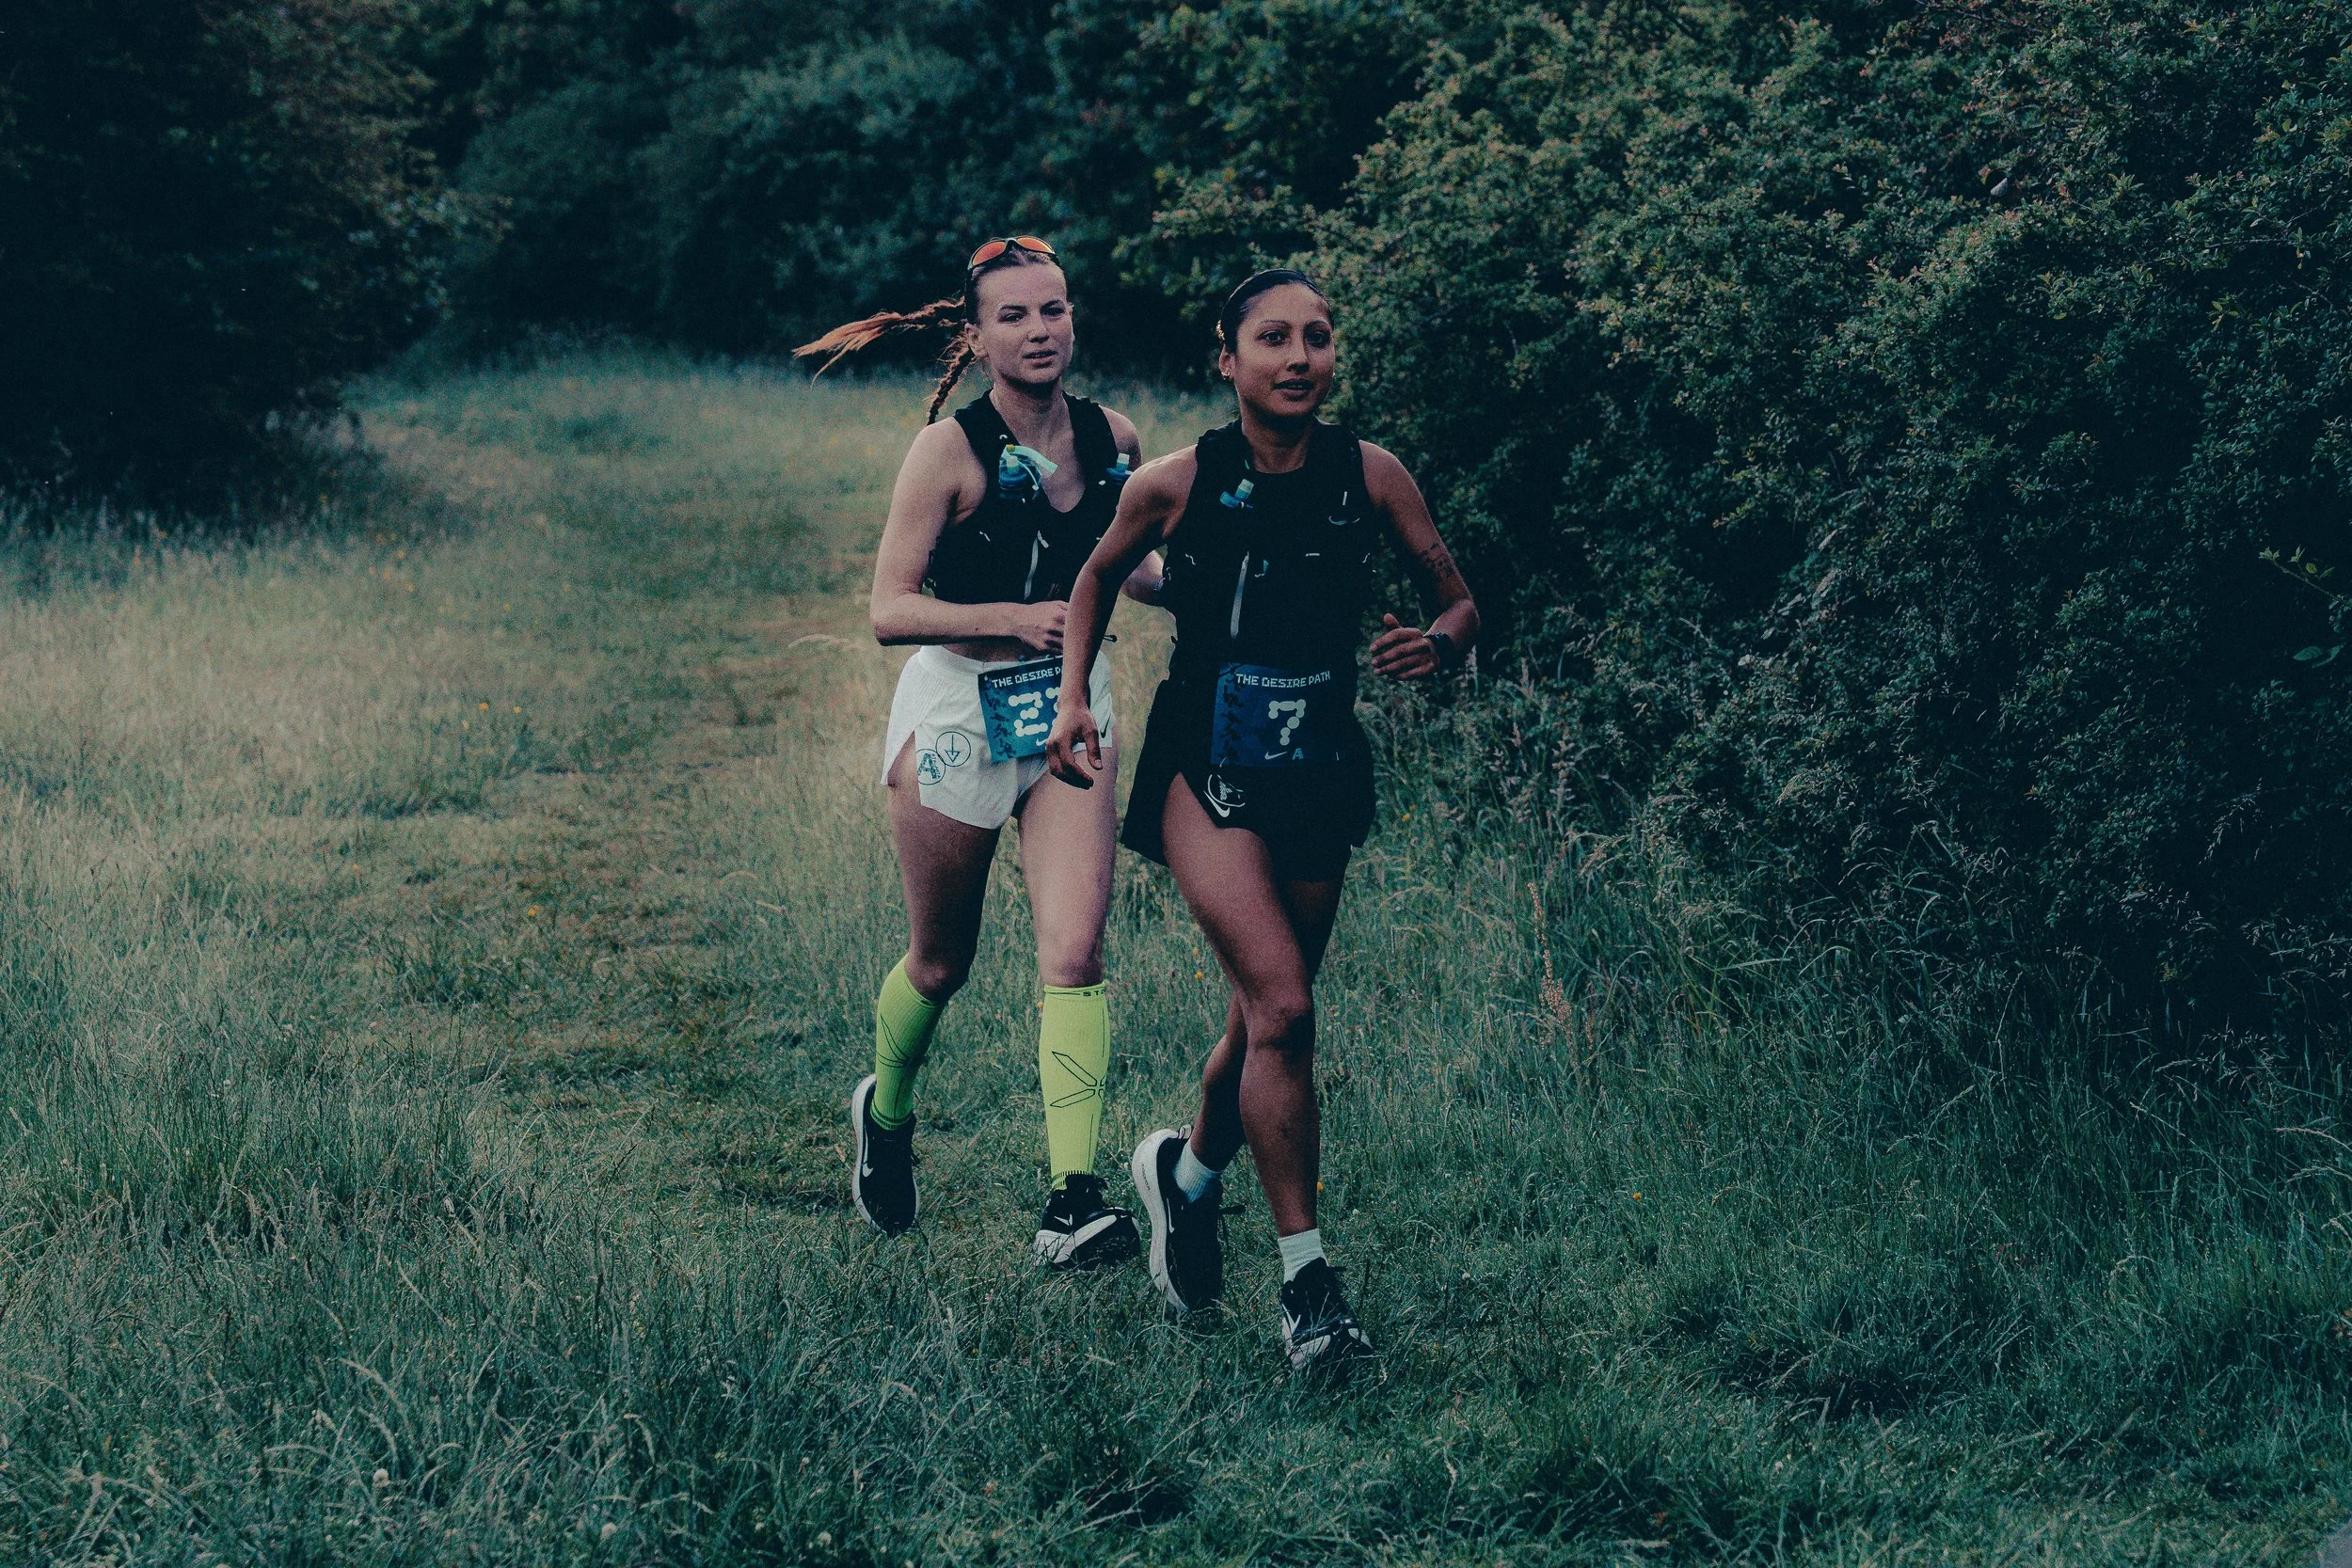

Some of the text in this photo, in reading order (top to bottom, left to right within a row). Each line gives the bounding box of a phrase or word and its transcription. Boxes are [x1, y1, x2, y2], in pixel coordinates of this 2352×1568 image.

[991, 675, 1014, 689] THE
[1014, 669, 1055, 685] DESIRE
[1235, 670, 1331, 689] THE DESIRE PATH
[1267, 698, 1307, 746] 7
[1292, 747, 1305, 761] A
